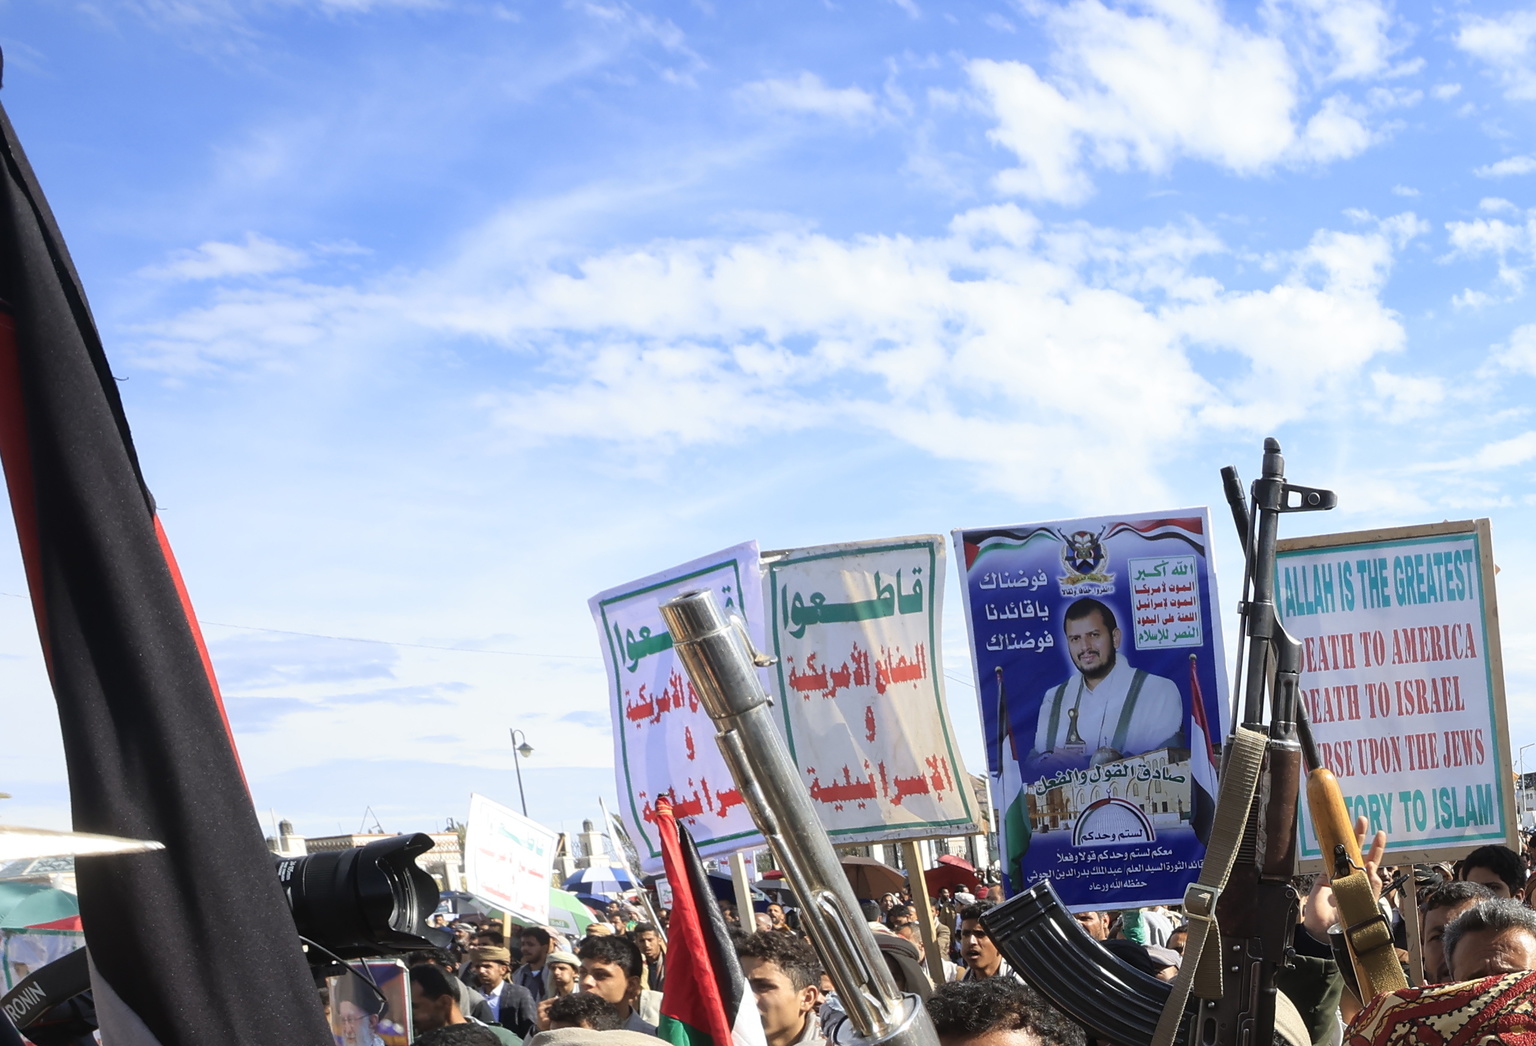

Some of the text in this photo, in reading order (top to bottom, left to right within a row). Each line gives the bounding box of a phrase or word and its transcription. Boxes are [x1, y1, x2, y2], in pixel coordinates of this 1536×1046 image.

[979, 569, 1047, 591] فوضناك
[1134, 560, 1193, 580] الله أكبر
[1285, 549, 1474, 617] ALLAH IS THE GREATEST
[782, 567, 922, 639] قاطعوا
[1169, 581, 1195, 594] الموت
[1170, 596, 1196, 608] الموت
[1137, 612, 1197, 626] اللعنة على اليهود
[986, 630, 1054, 653] فوضناك
[1139, 626, 1199, 644] النصر للإسلام
[1360, 630, 1386, 667] TO
[1392, 623, 1477, 664] AMERICA
[787, 641, 926, 701] البضائع الأمريكية
[1365, 682, 1391, 718] TO
[1395, 676, 1465, 717] ISRAEL
[865, 706, 876, 743] و
[685, 726, 695, 762] و
[1357, 736, 1402, 776] UPON
[1404, 732, 1439, 771] THE
[1443, 728, 1485, 769] JEWS
[806, 753, 954, 812] الإسرائيلية
[1036, 764, 1186, 795] صادق القول والفعل
[1399, 789, 1427, 833] TO
[1432, 783, 1495, 830] ISLAM
[1080, 829, 1143, 844] لستم وحدكم
[1097, 850, 1128, 862] وحدكم
[1129, 848, 1150, 860] لستم
[1151, 846, 1173, 859] معكم
[4, 981, 47, 1022] RONIN
